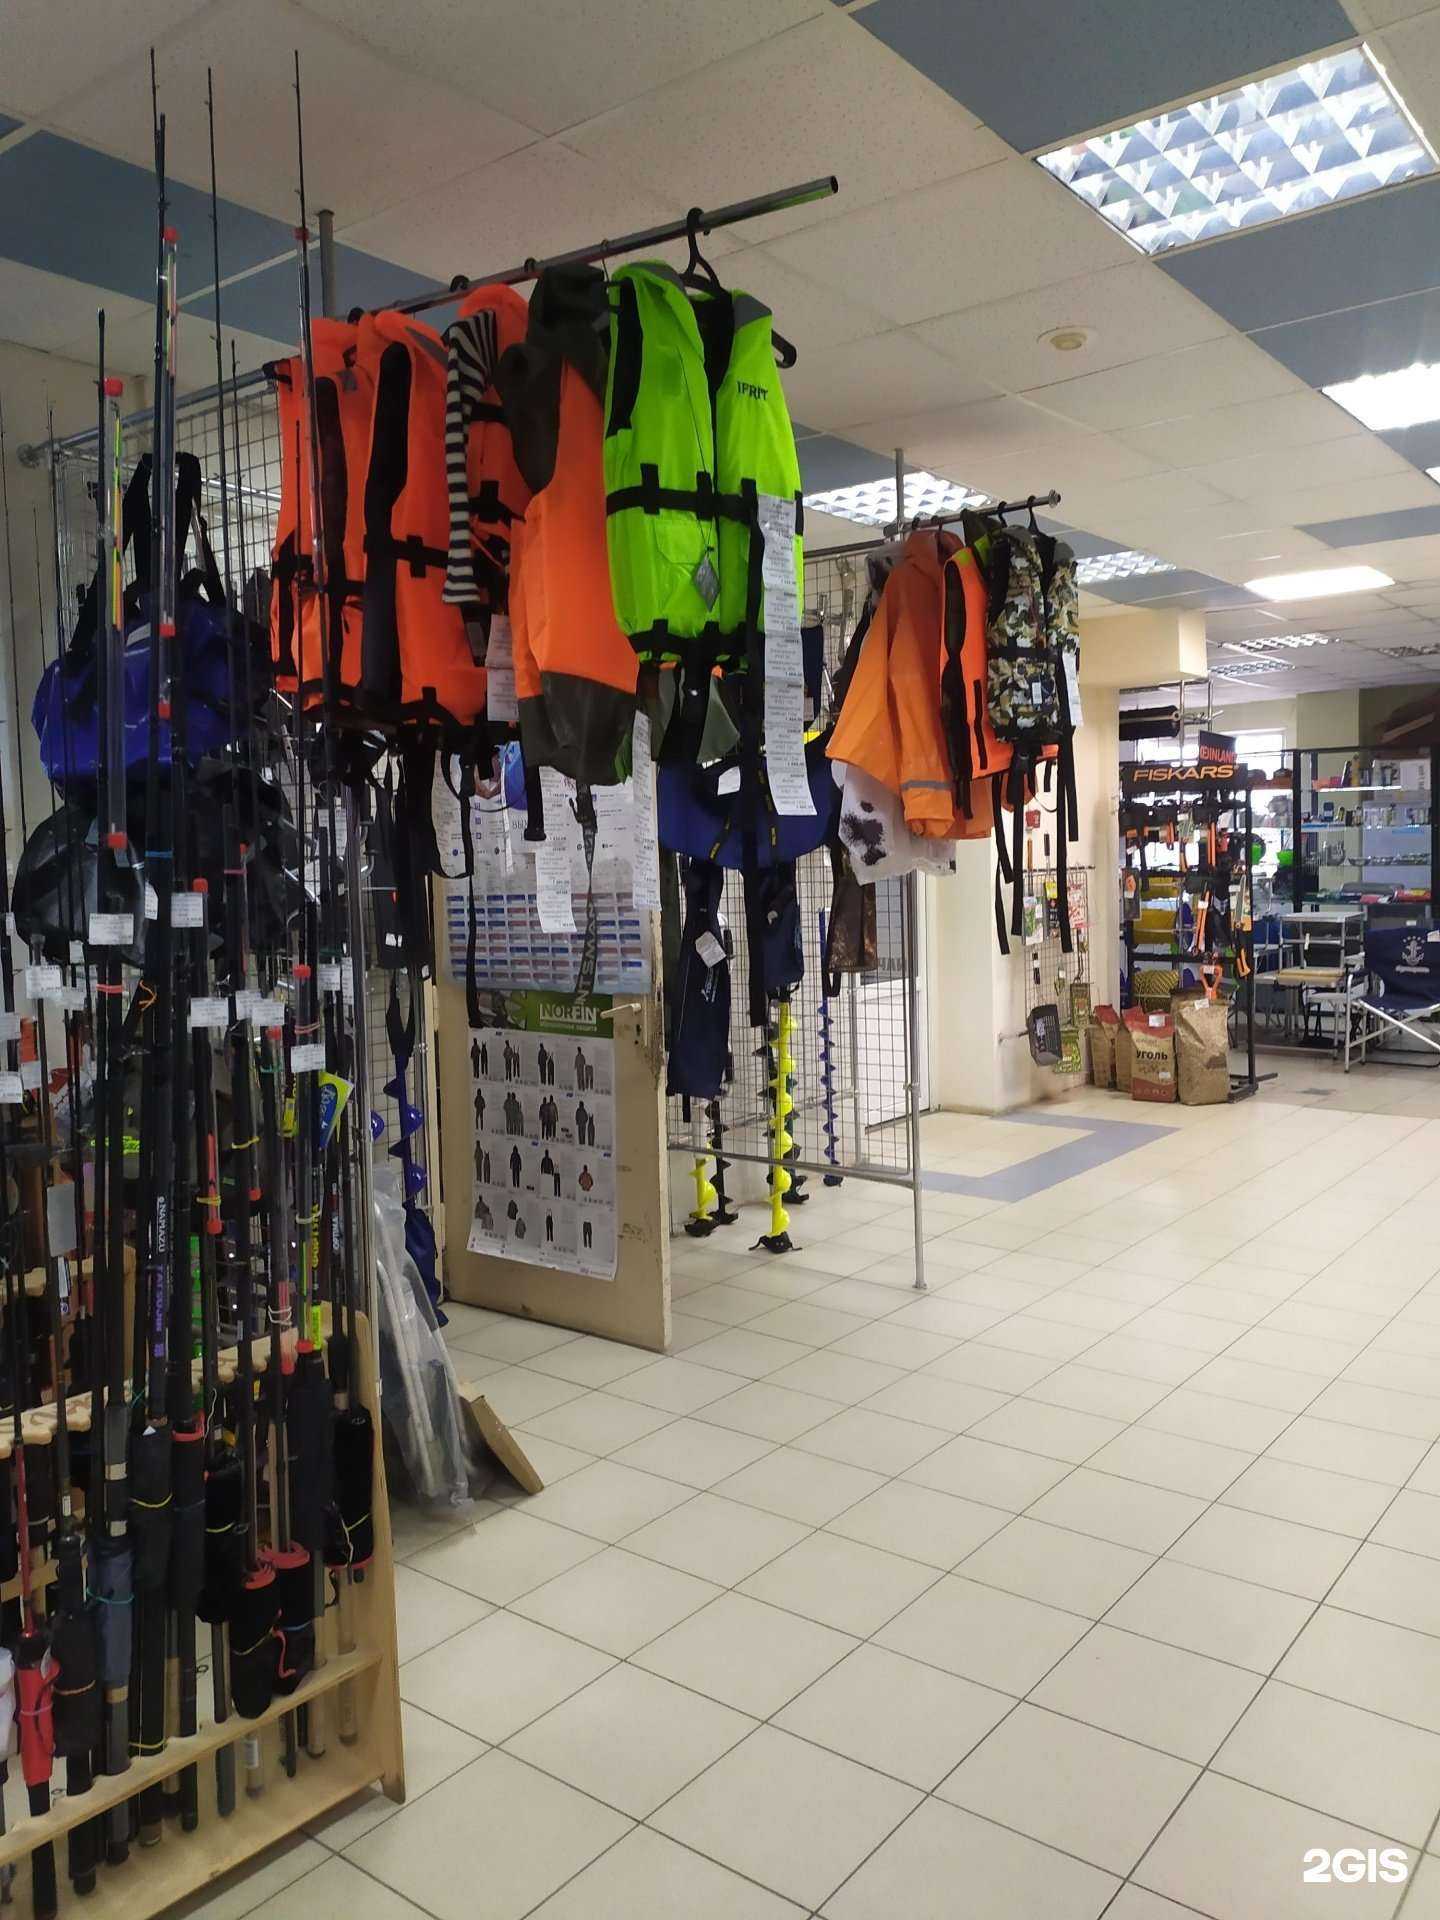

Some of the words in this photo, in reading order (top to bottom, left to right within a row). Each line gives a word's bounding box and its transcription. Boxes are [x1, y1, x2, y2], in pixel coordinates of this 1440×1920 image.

[736, 381, 769, 401] IFRIT
[1133, 765, 1234, 782] FISKARS
[539, 1003, 597, 1023] NORFIN
[158, 1202, 166, 1253] NAMAZU
